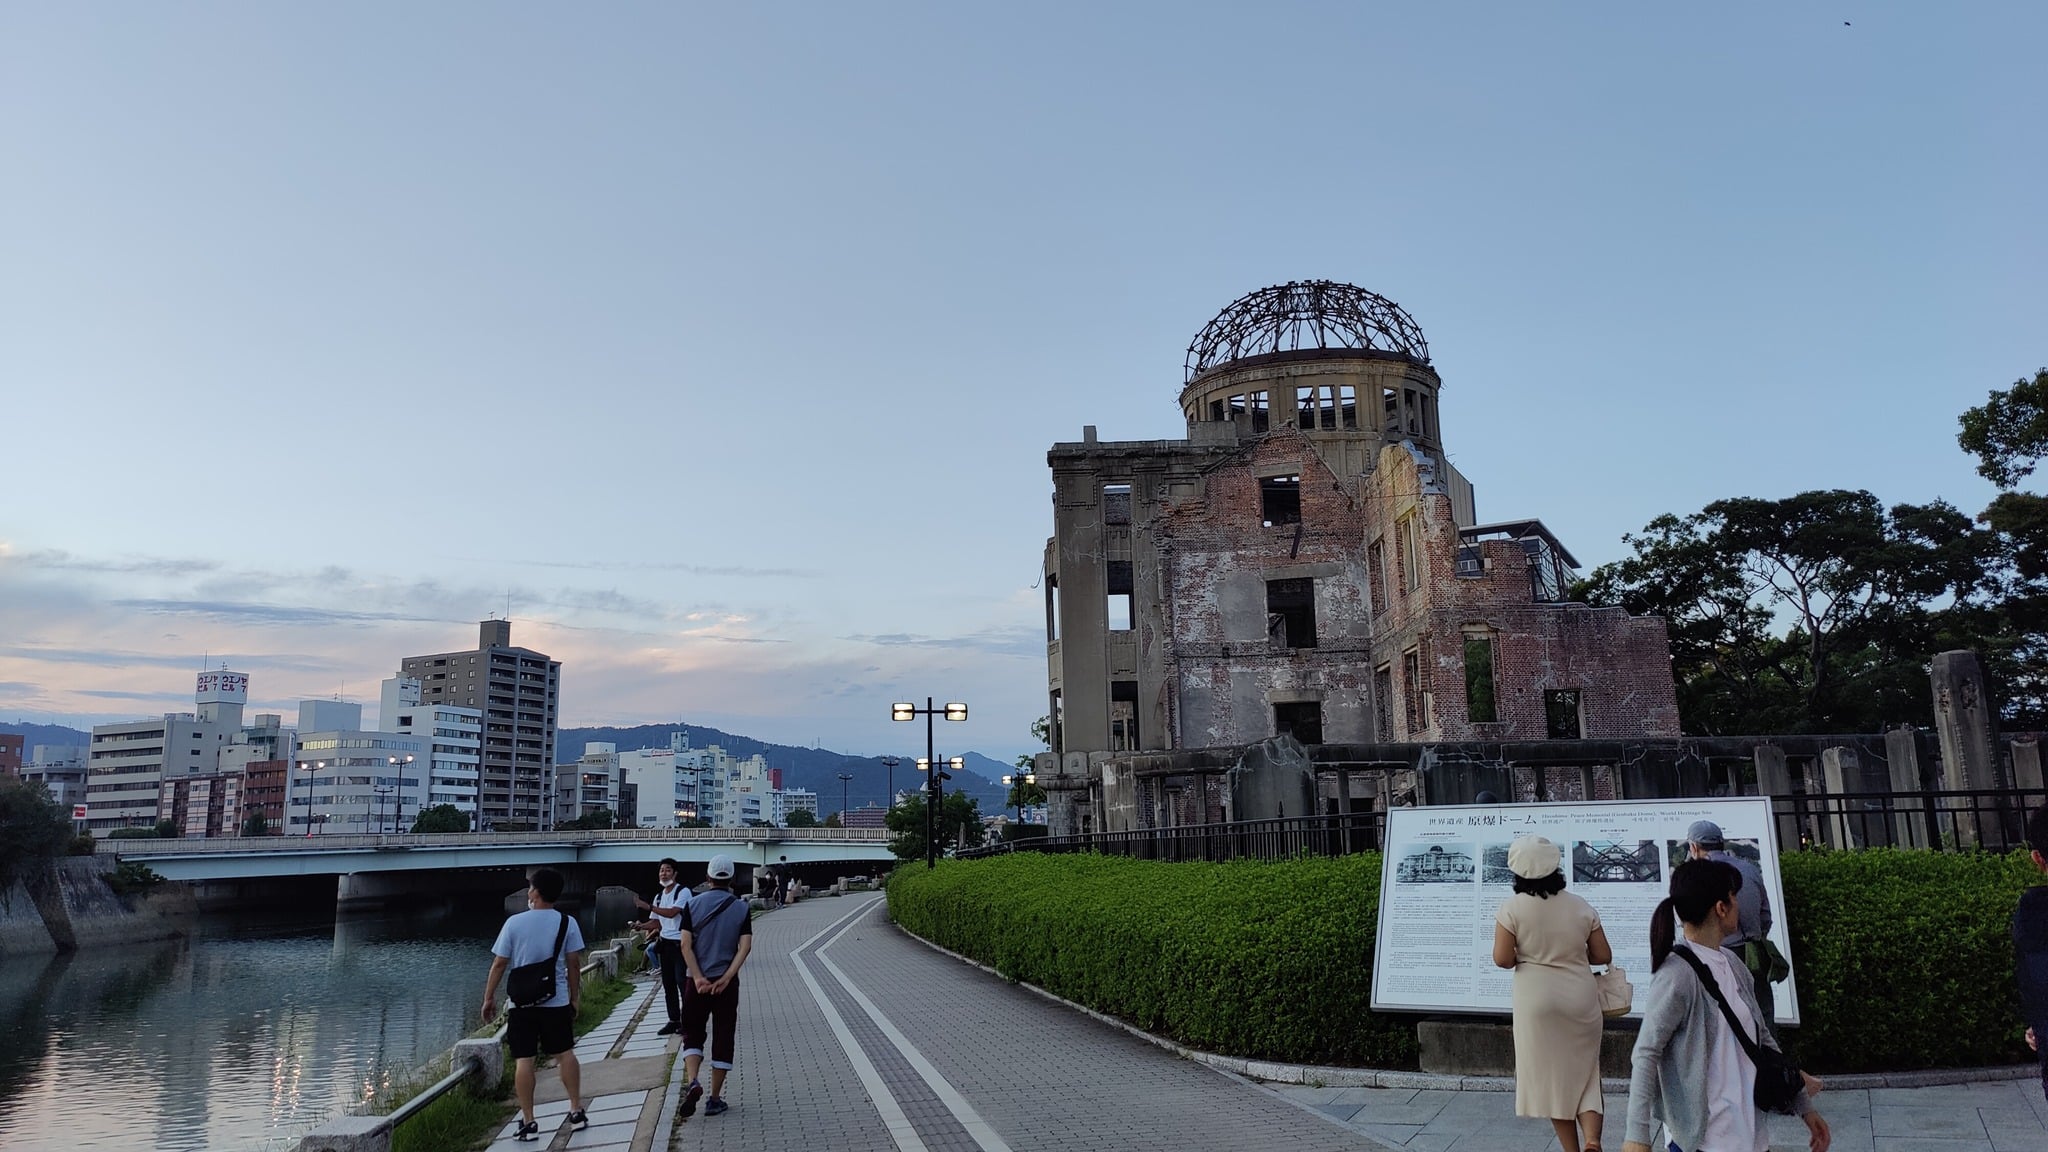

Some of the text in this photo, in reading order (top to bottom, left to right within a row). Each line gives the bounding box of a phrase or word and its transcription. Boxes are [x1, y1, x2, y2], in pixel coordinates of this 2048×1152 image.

[222, 675, 248, 684] ウエノヤ
[1428, 814, 1537, 827] 世界遺産 原爆ドーム
